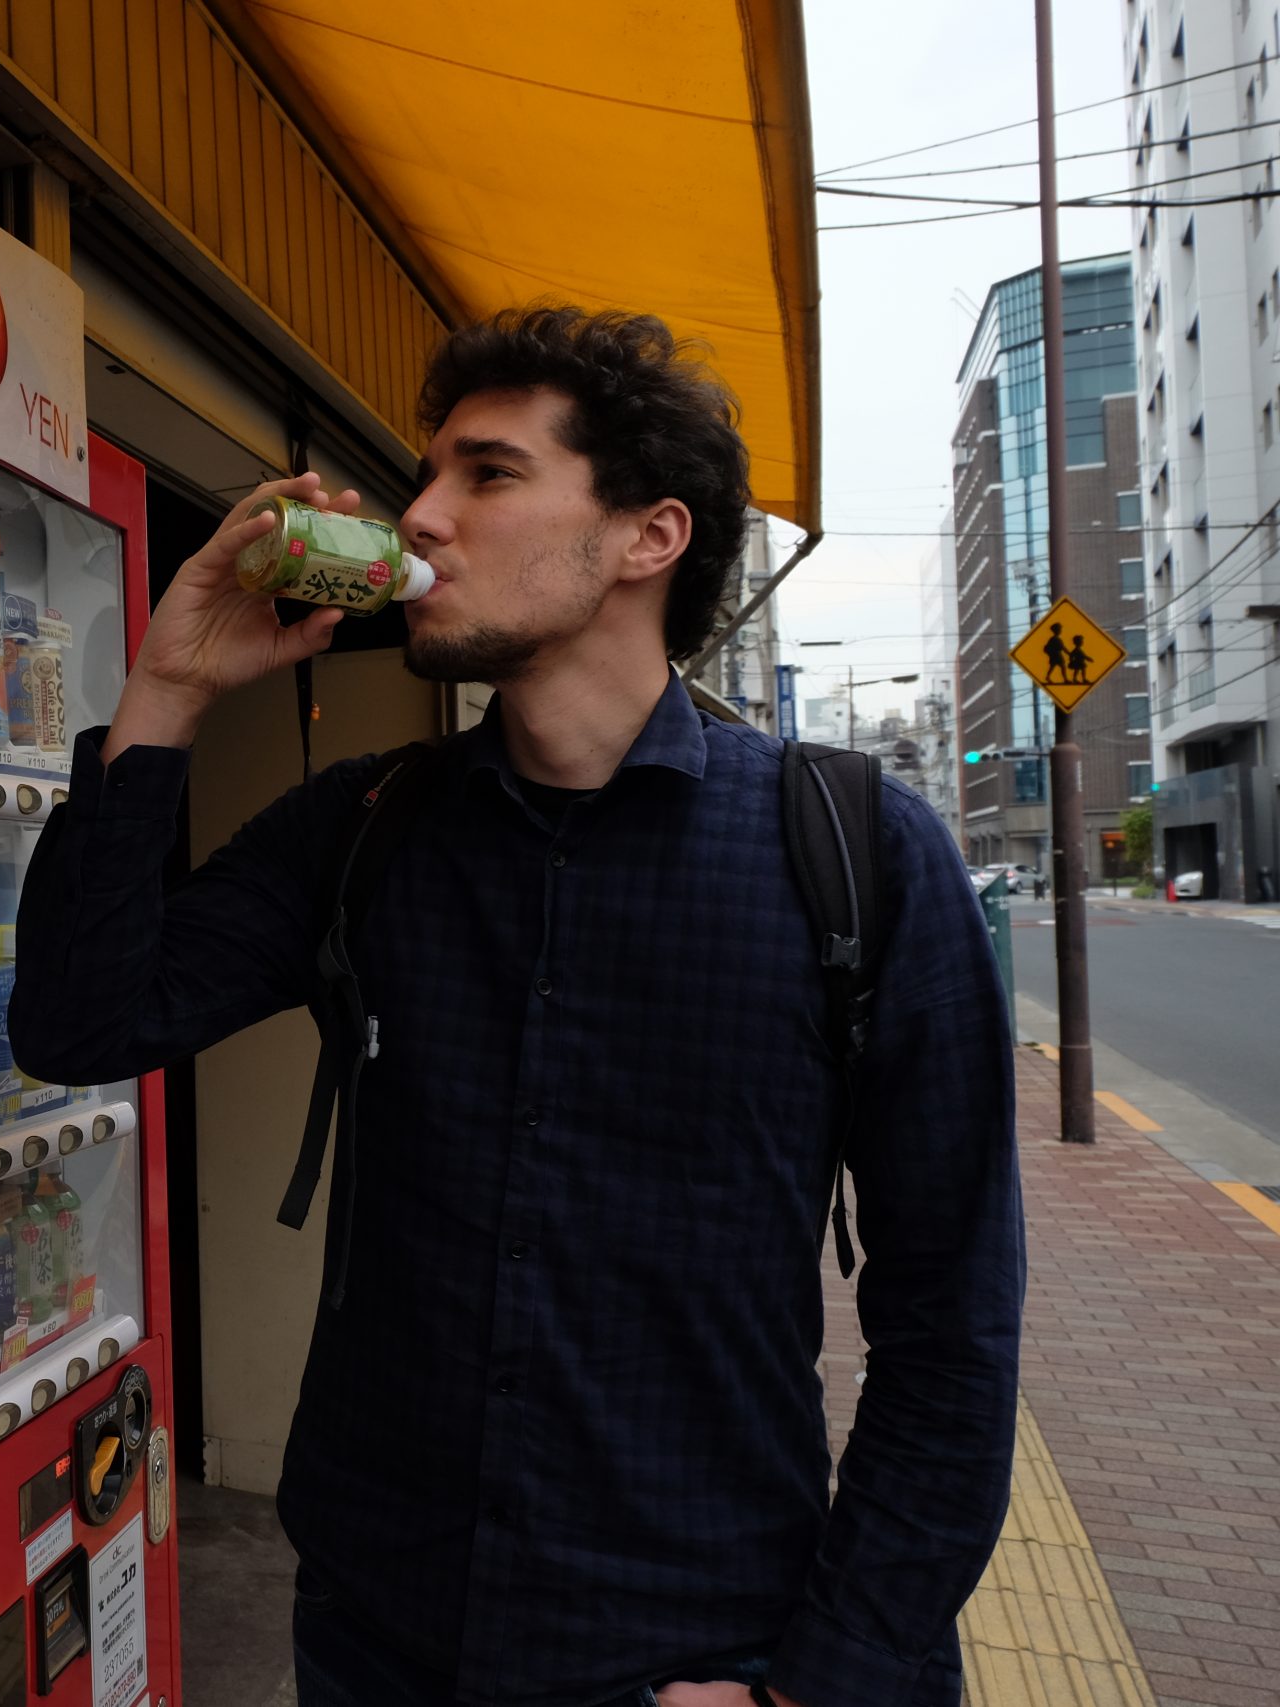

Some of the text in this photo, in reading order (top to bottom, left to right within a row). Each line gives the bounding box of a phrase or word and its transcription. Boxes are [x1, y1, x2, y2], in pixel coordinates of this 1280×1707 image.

[20, 383, 68, 458] YEN
[5, 605, 20, 619] NEW
[27, 757, 46, 769] ¥110
[35, 1090, 53, 1105] ¥110
